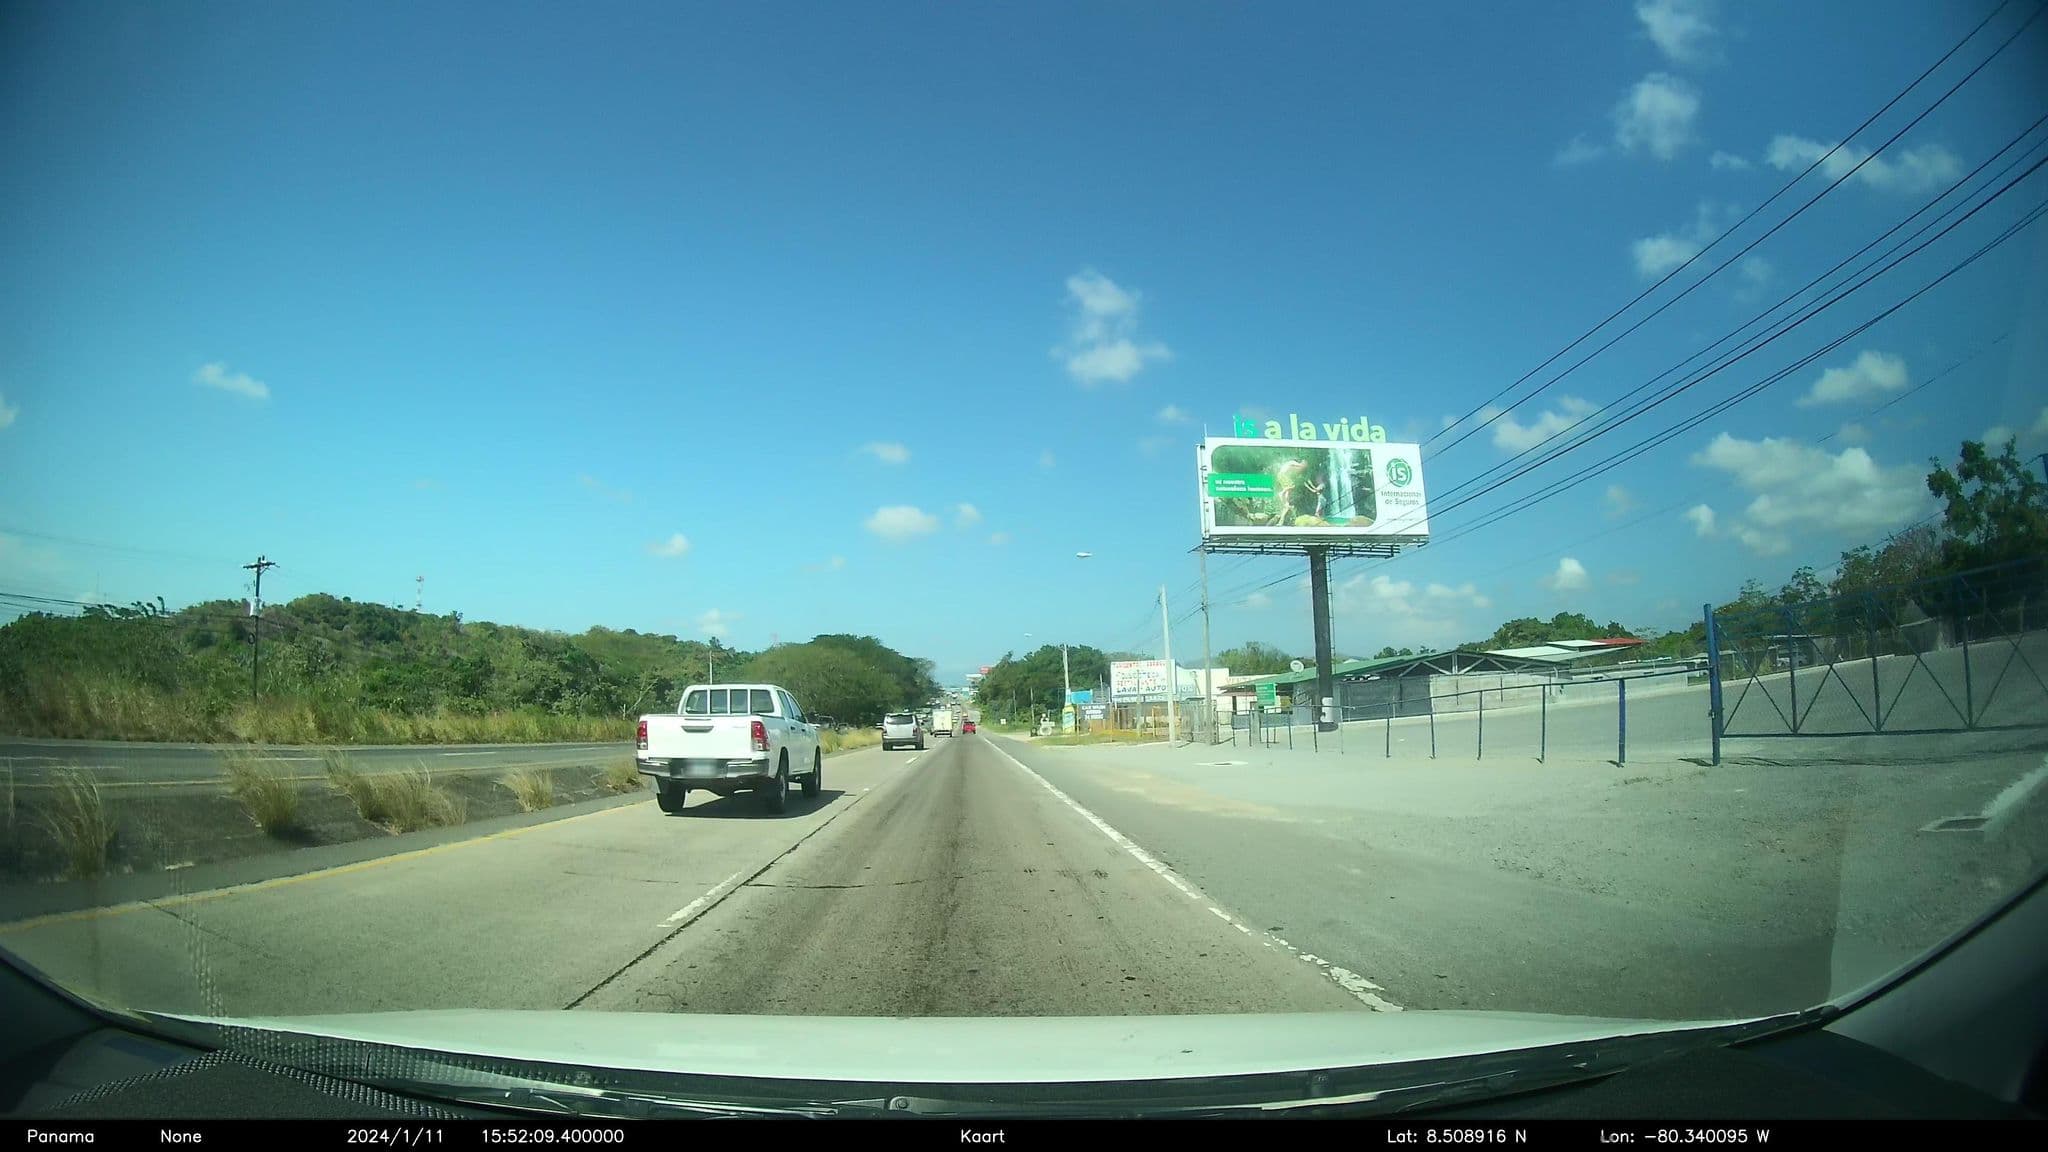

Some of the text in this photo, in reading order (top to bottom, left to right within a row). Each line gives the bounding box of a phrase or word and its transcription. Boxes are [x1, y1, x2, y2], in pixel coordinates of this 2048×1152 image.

[1264, 420, 1282, 439] a
[1289, 414, 1317, 440] la
[1322, 416, 1386, 443] vida
